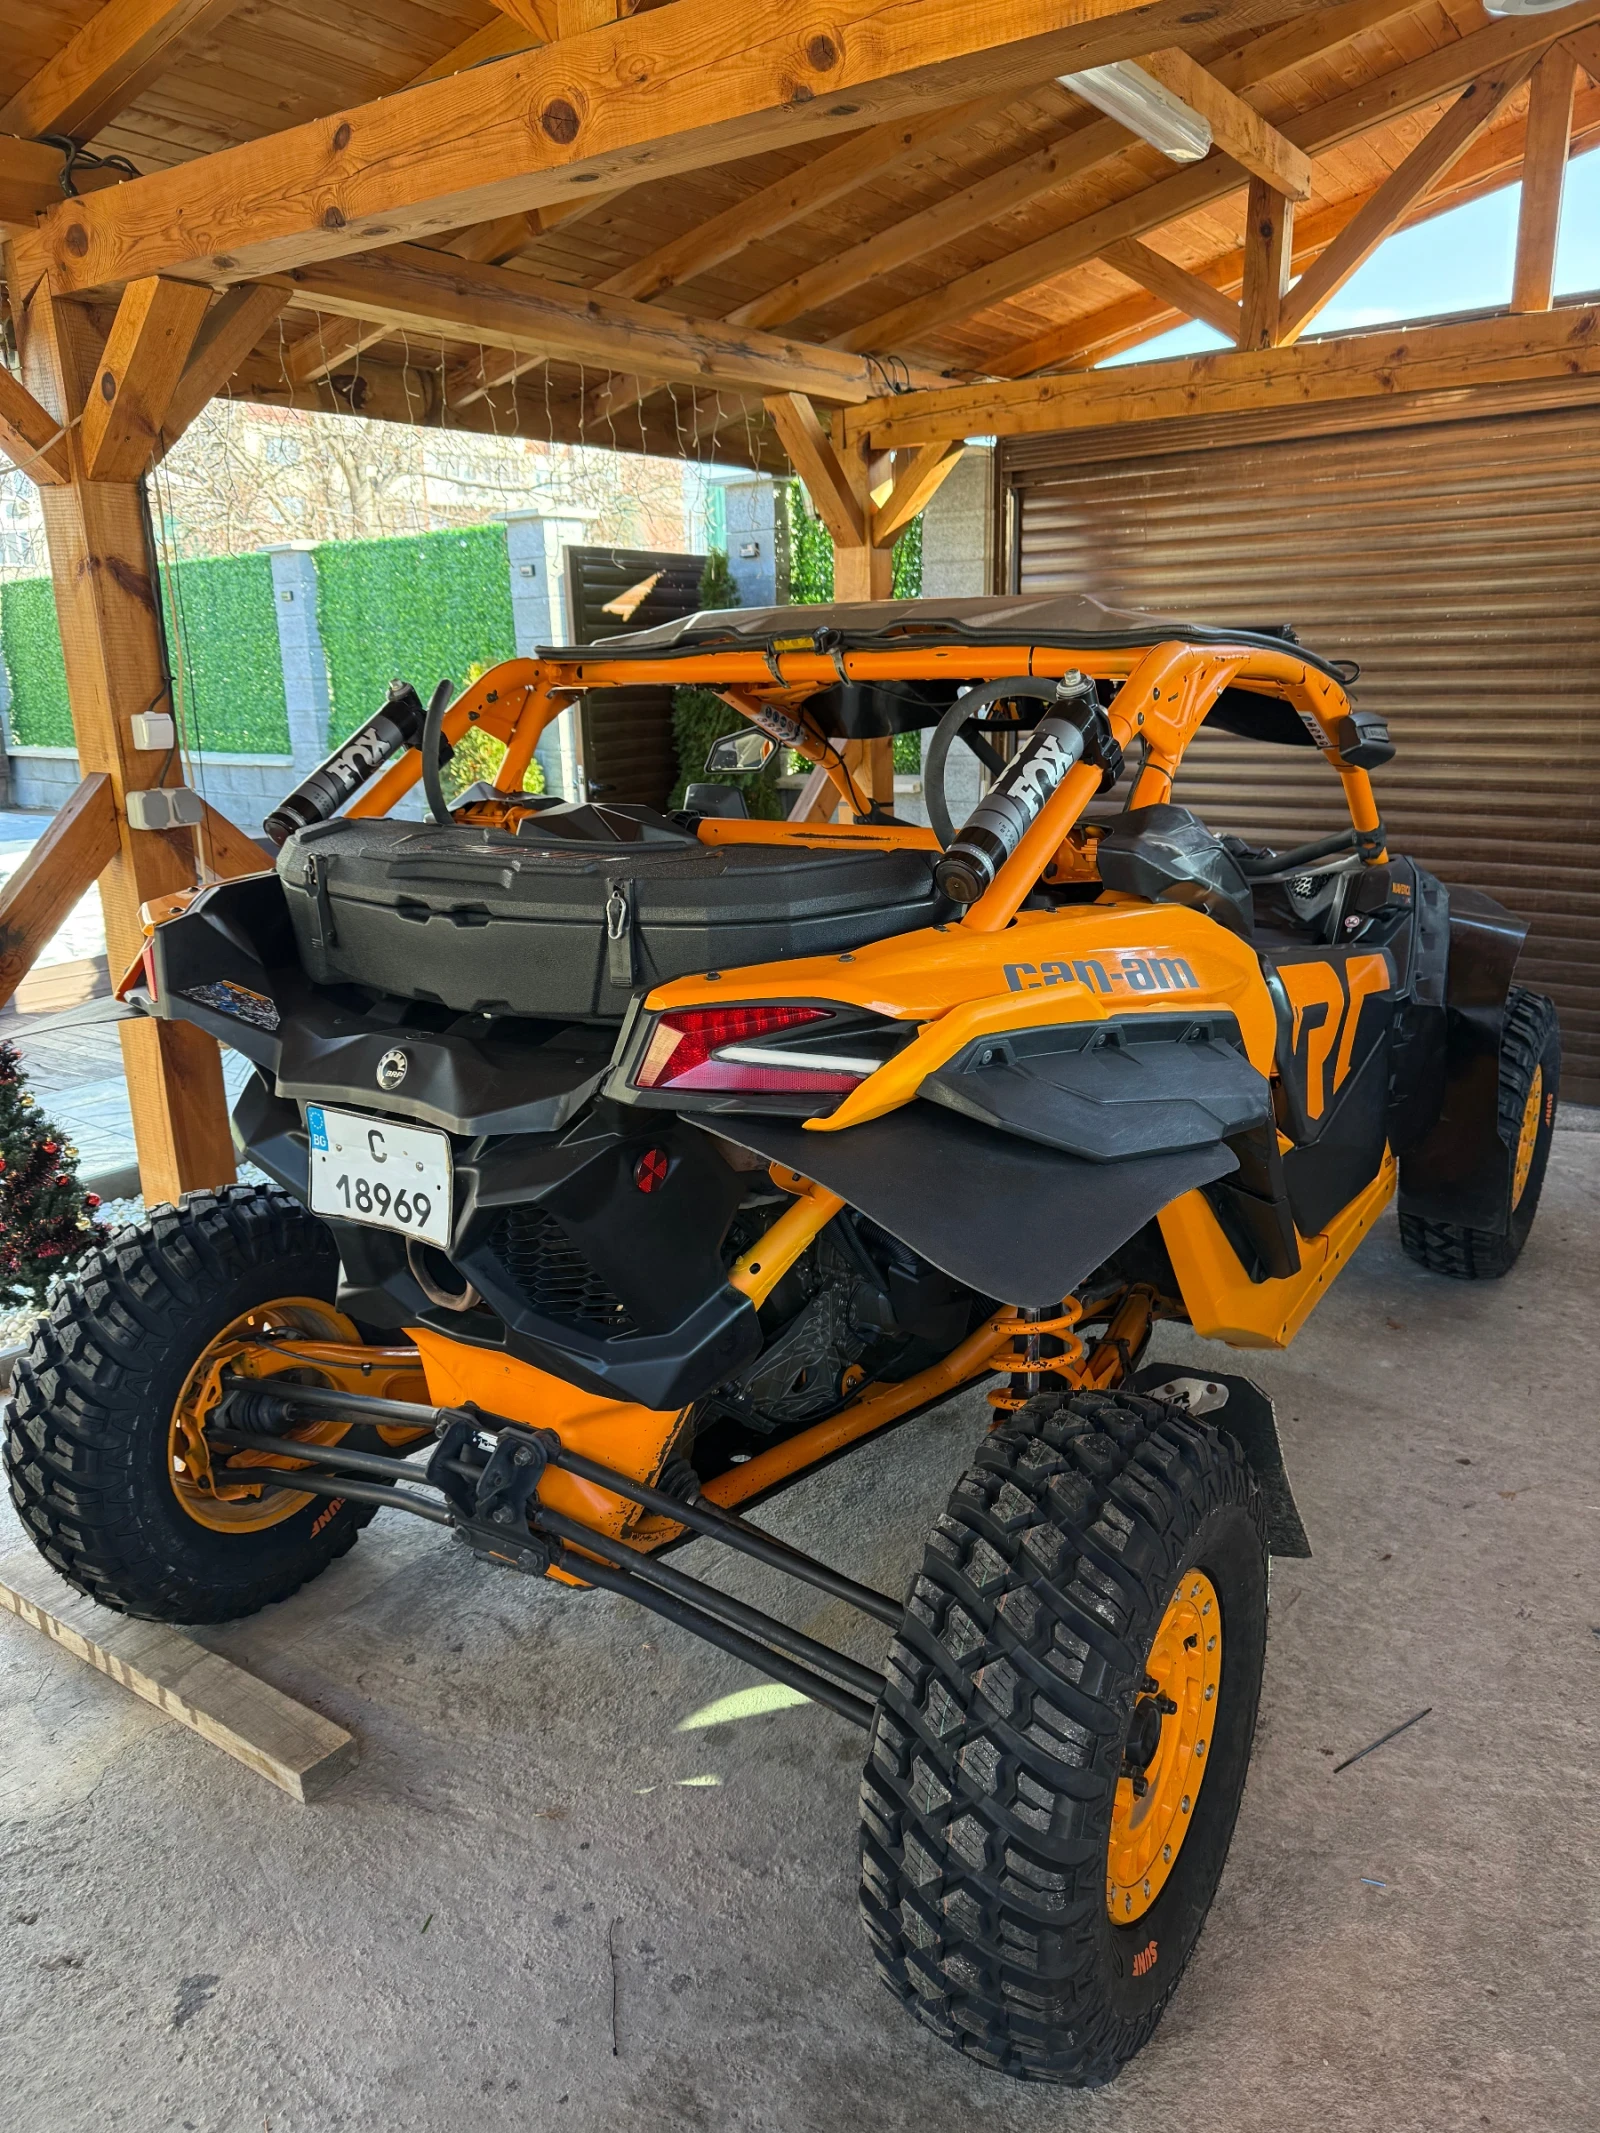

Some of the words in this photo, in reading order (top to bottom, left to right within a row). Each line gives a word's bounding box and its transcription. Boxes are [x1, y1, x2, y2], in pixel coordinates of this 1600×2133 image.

[326, 727, 392, 790] FOX
[1007, 734, 1074, 821] FOX
[1003, 957, 1200, 994] can-am
[385, 1070, 404, 1078] BRP
[313, 1133, 327, 1147] BG
[367, 1129, 388, 1164] C
[335, 1173, 432, 1228] 18969
[1132, 1940, 1158, 1977] SUNF
